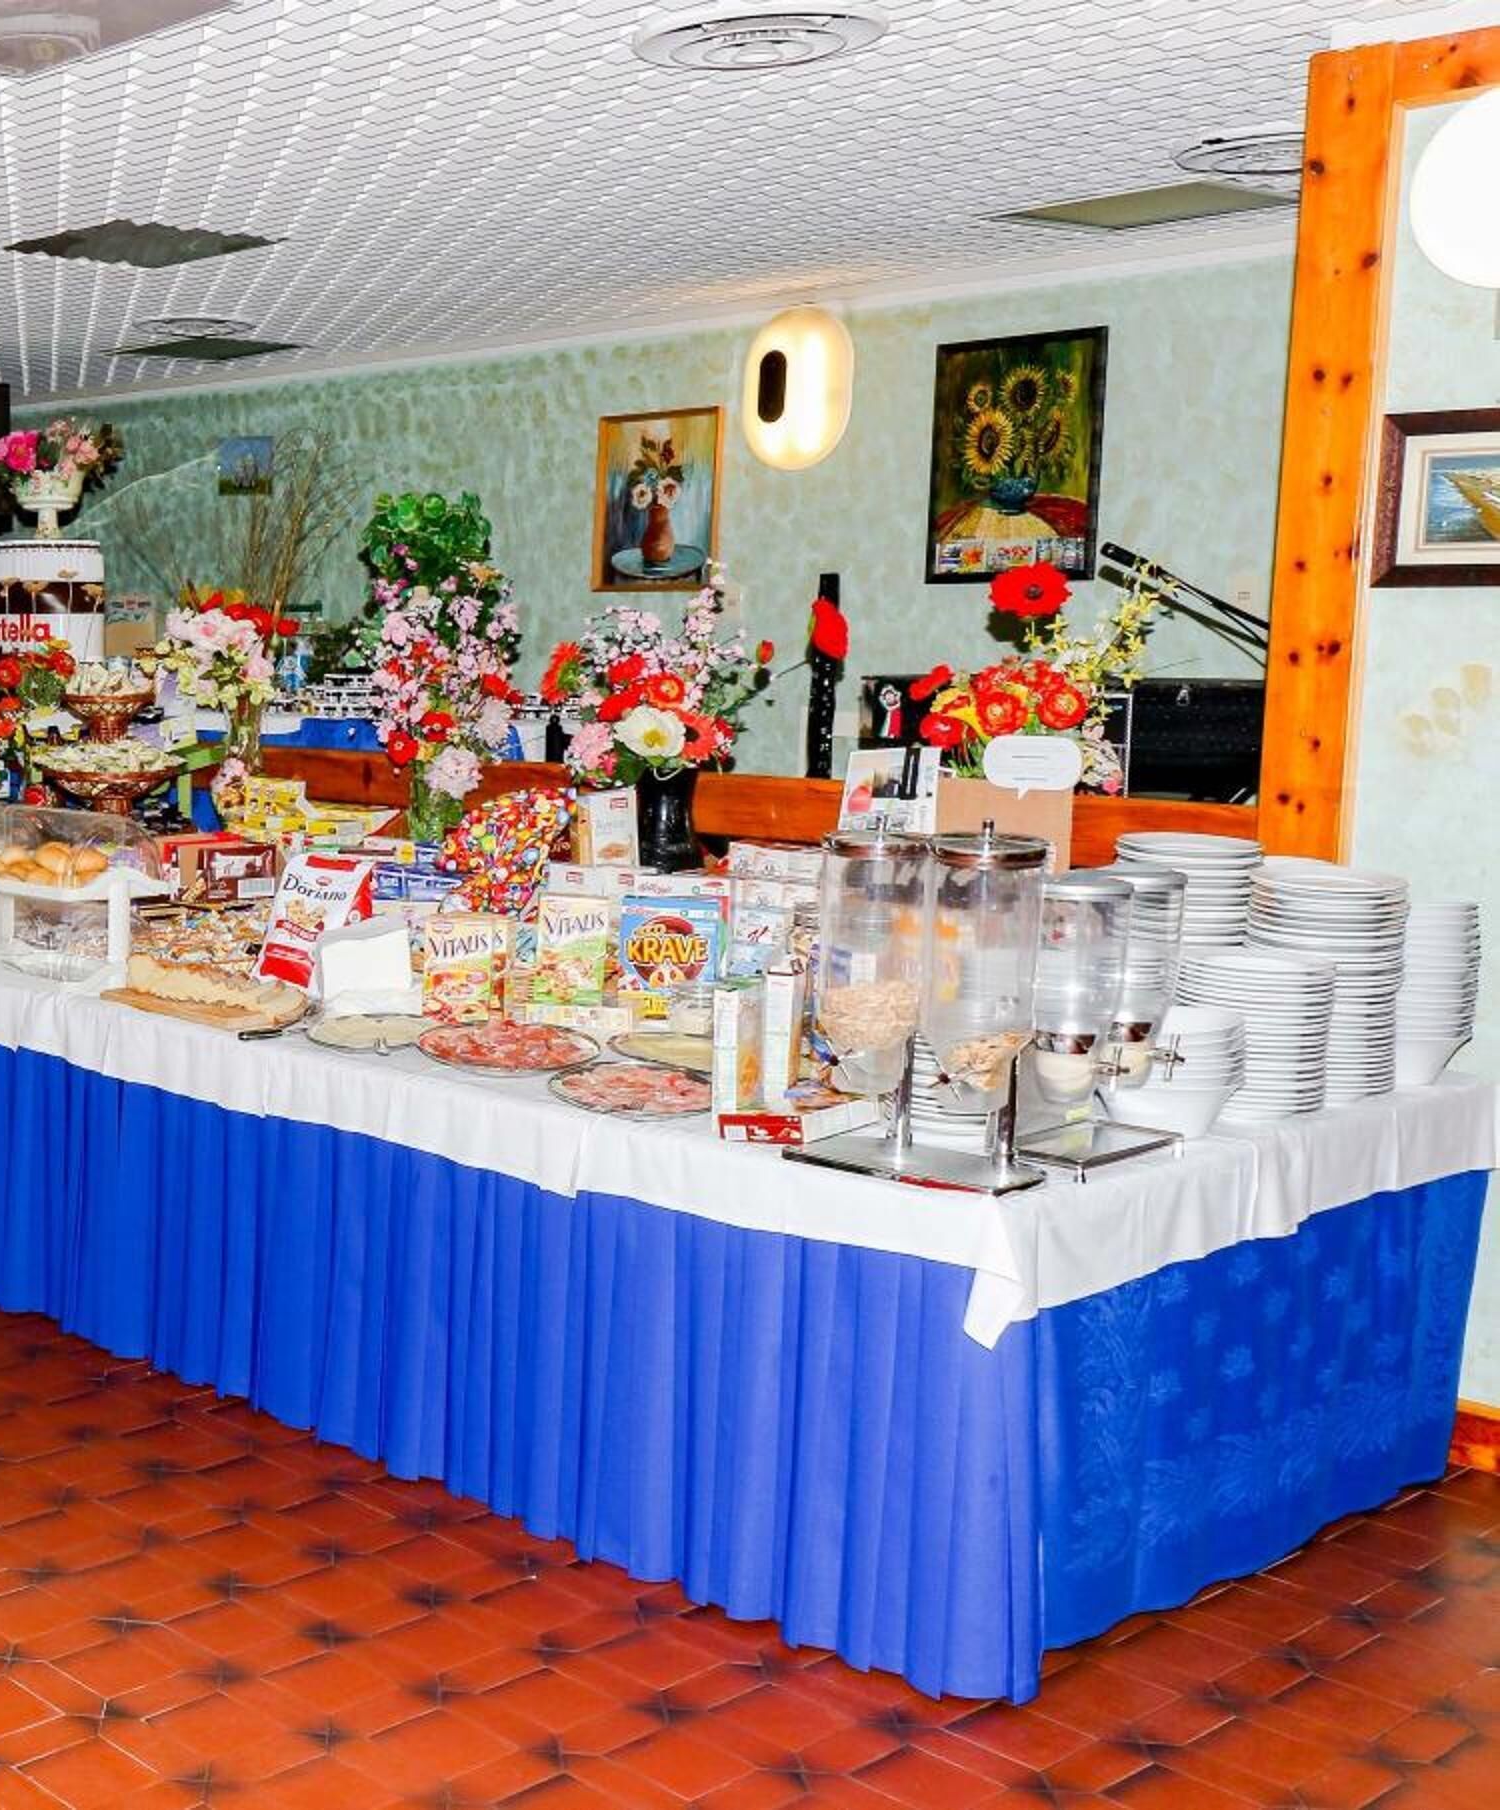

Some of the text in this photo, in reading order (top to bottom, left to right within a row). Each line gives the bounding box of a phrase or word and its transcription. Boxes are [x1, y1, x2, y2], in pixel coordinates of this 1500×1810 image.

[283, 873, 348, 901] Doriano
[543, 912, 605, 936] VITALIS
[429, 932, 488, 957] VITALIS
[625, 935, 709, 966] KRAVE
